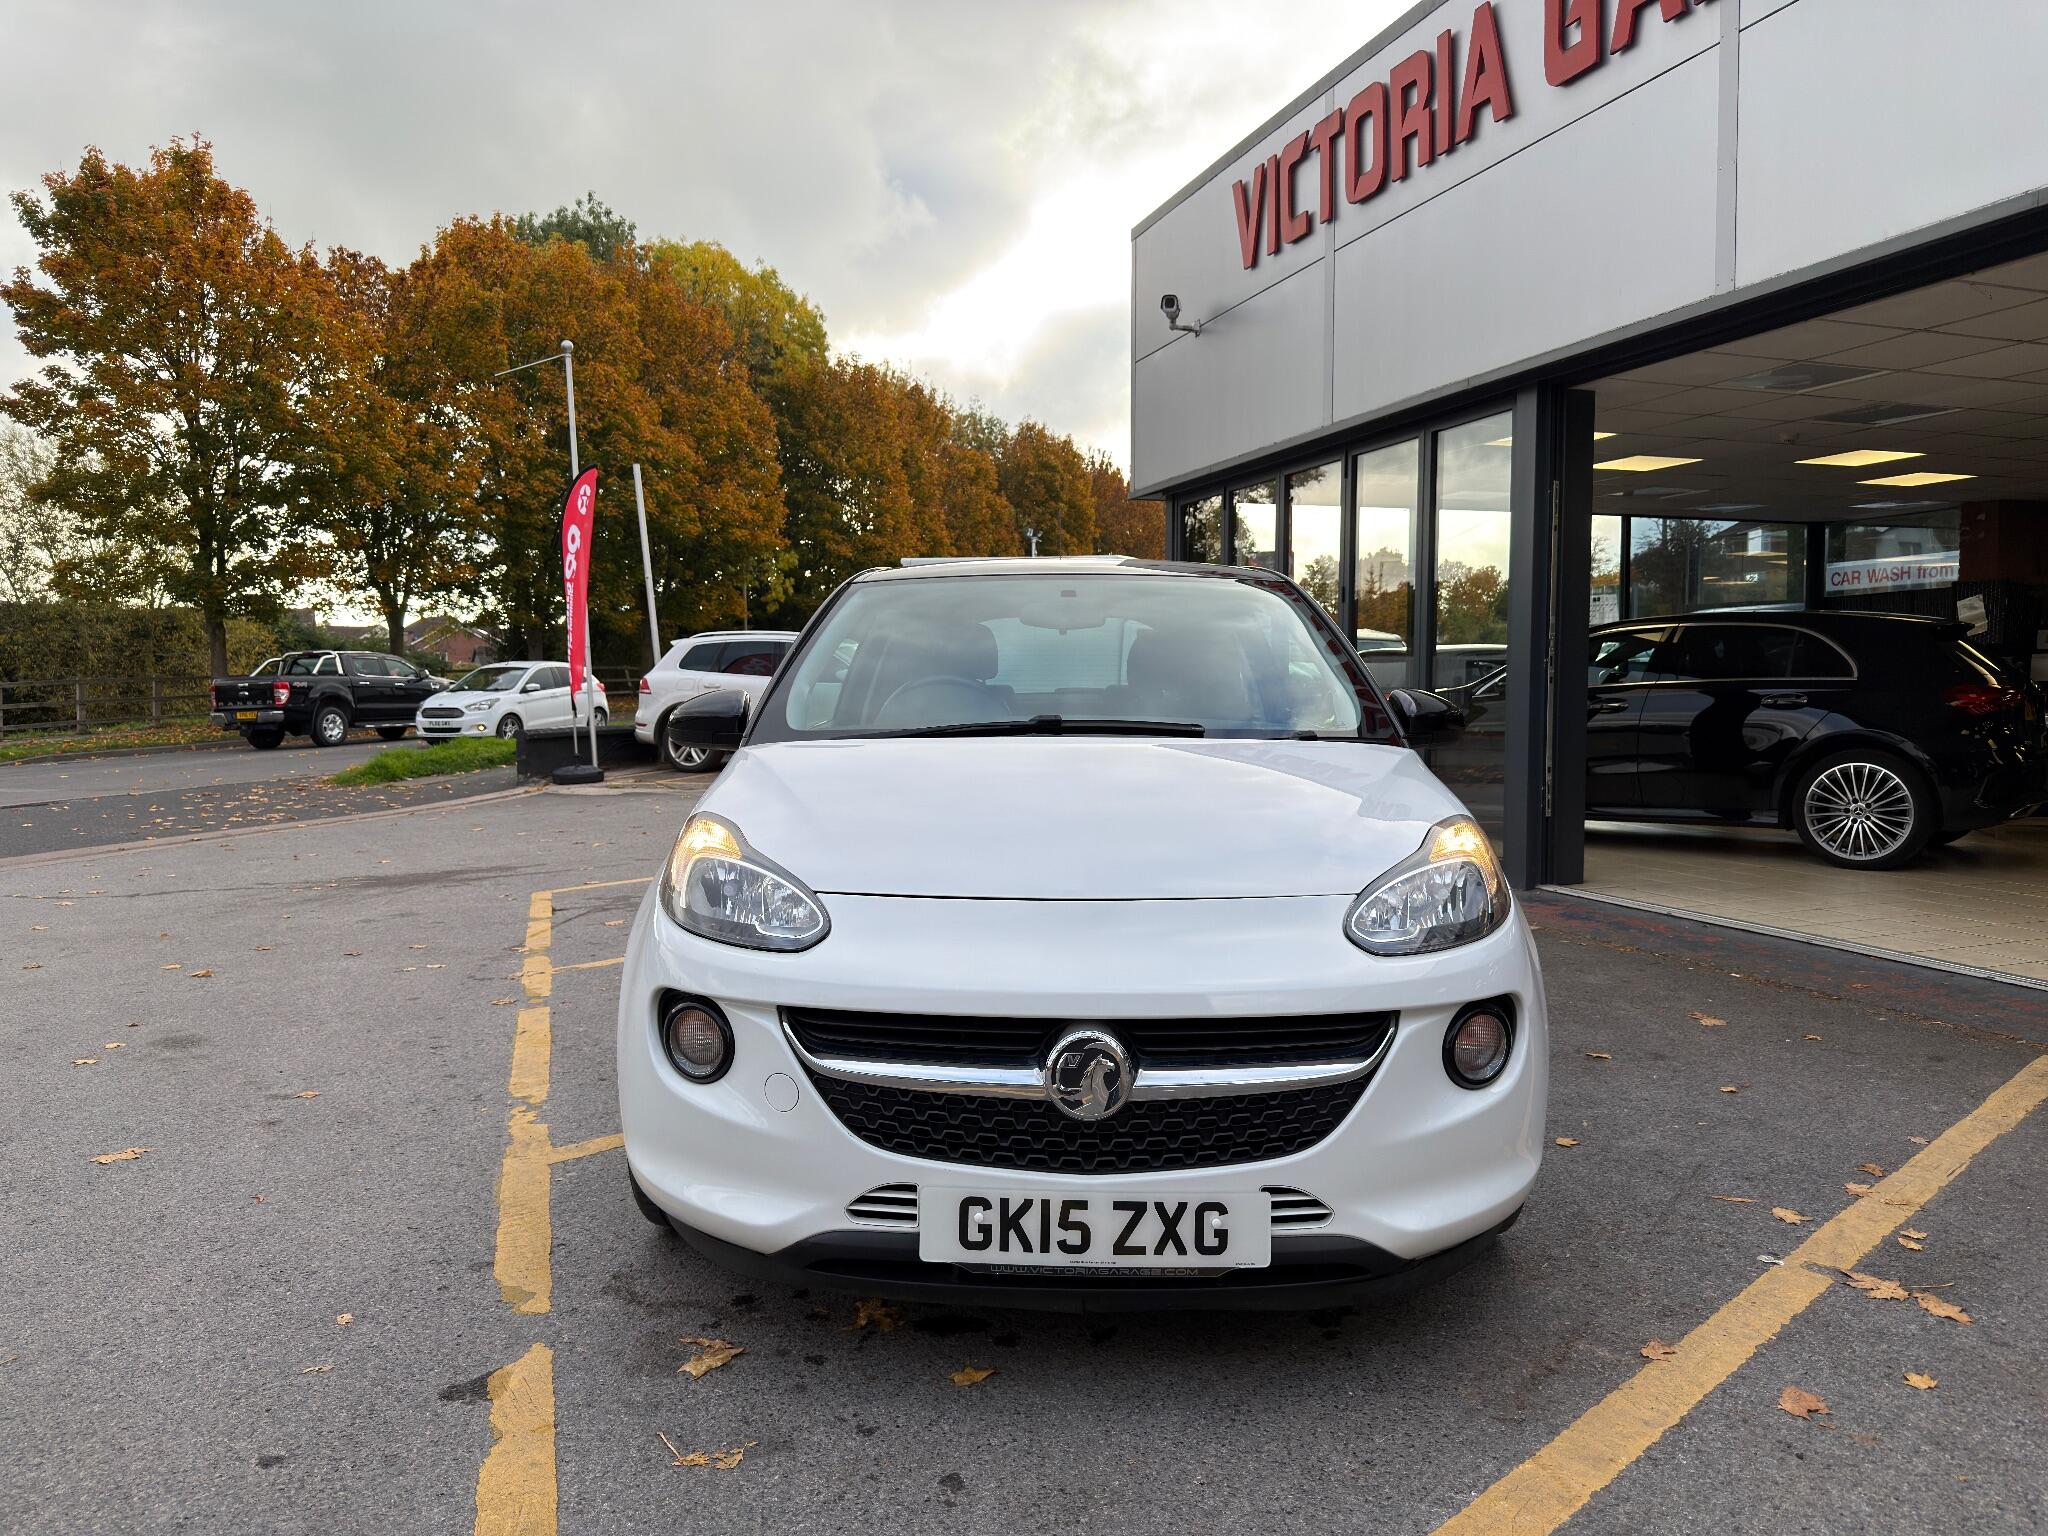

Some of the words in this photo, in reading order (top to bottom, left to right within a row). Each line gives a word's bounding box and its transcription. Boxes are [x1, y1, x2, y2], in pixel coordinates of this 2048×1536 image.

[1232, 1, 1512, 270] VICTORIA
[1831, 570, 1861, 587] CAR
[1867, 565, 1911, 584] WASH
[1917, 564, 1954, 579] from
[959, 1196, 1092, 1255] GK15
[1113, 1200, 1229, 1257] ZXG
